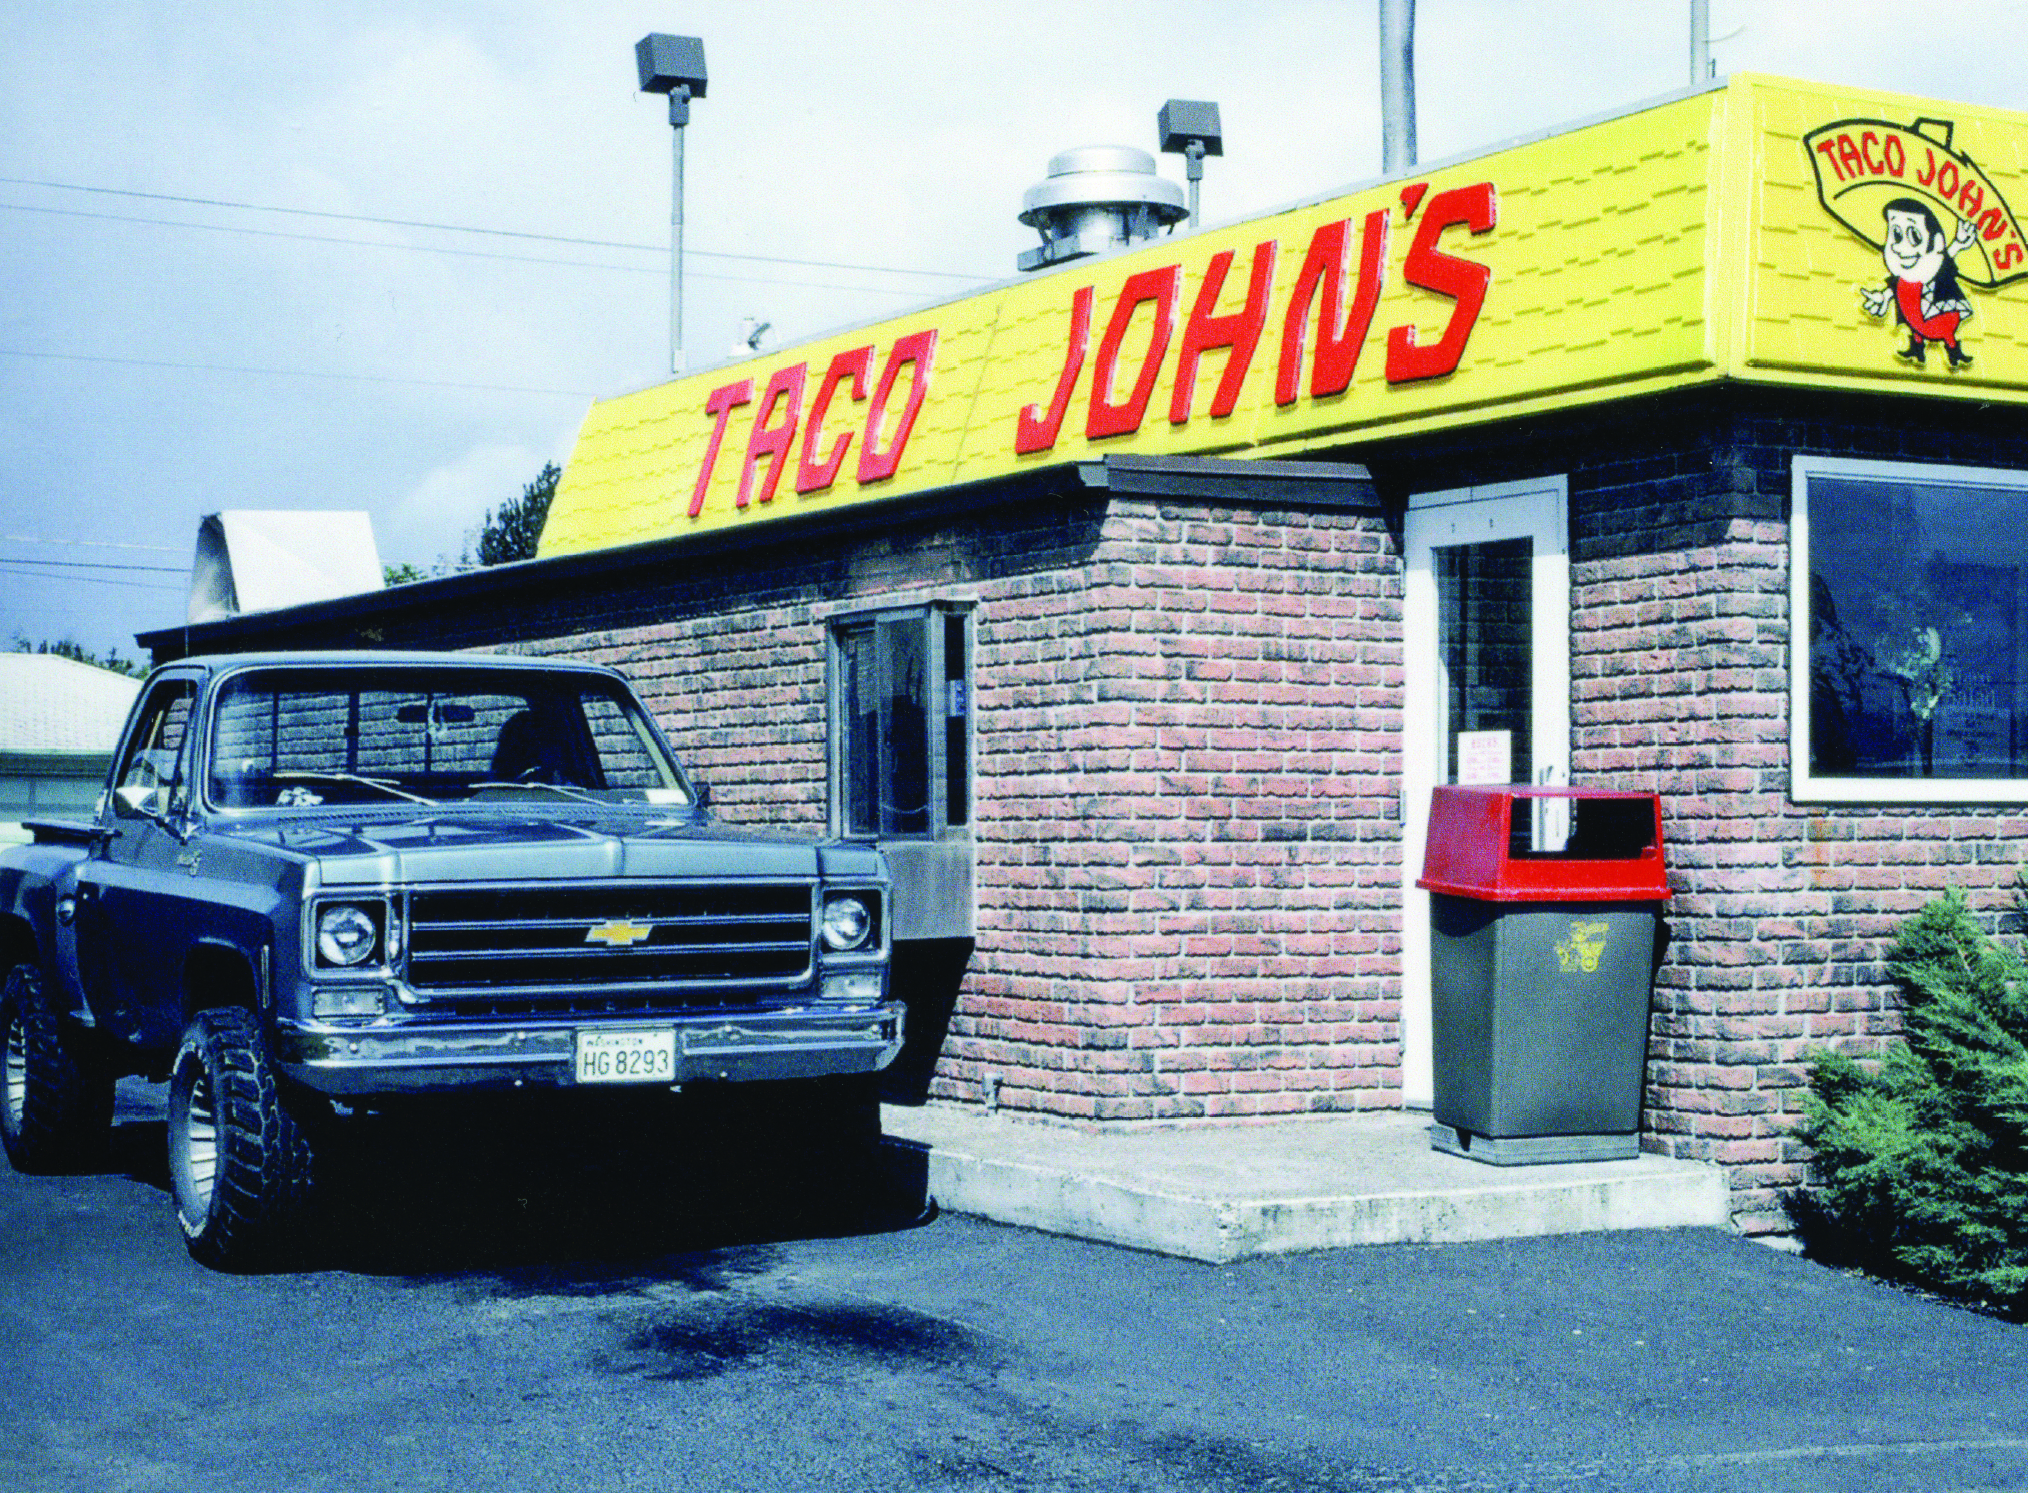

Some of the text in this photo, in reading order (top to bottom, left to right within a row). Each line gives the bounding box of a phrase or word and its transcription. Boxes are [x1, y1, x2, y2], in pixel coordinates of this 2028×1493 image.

[1817, 131, 2024, 270] TACO JOHN'S
[687, 181, 1497, 519] TACO JOHN'S
[584, 1049, 669, 1076] HG 8293
